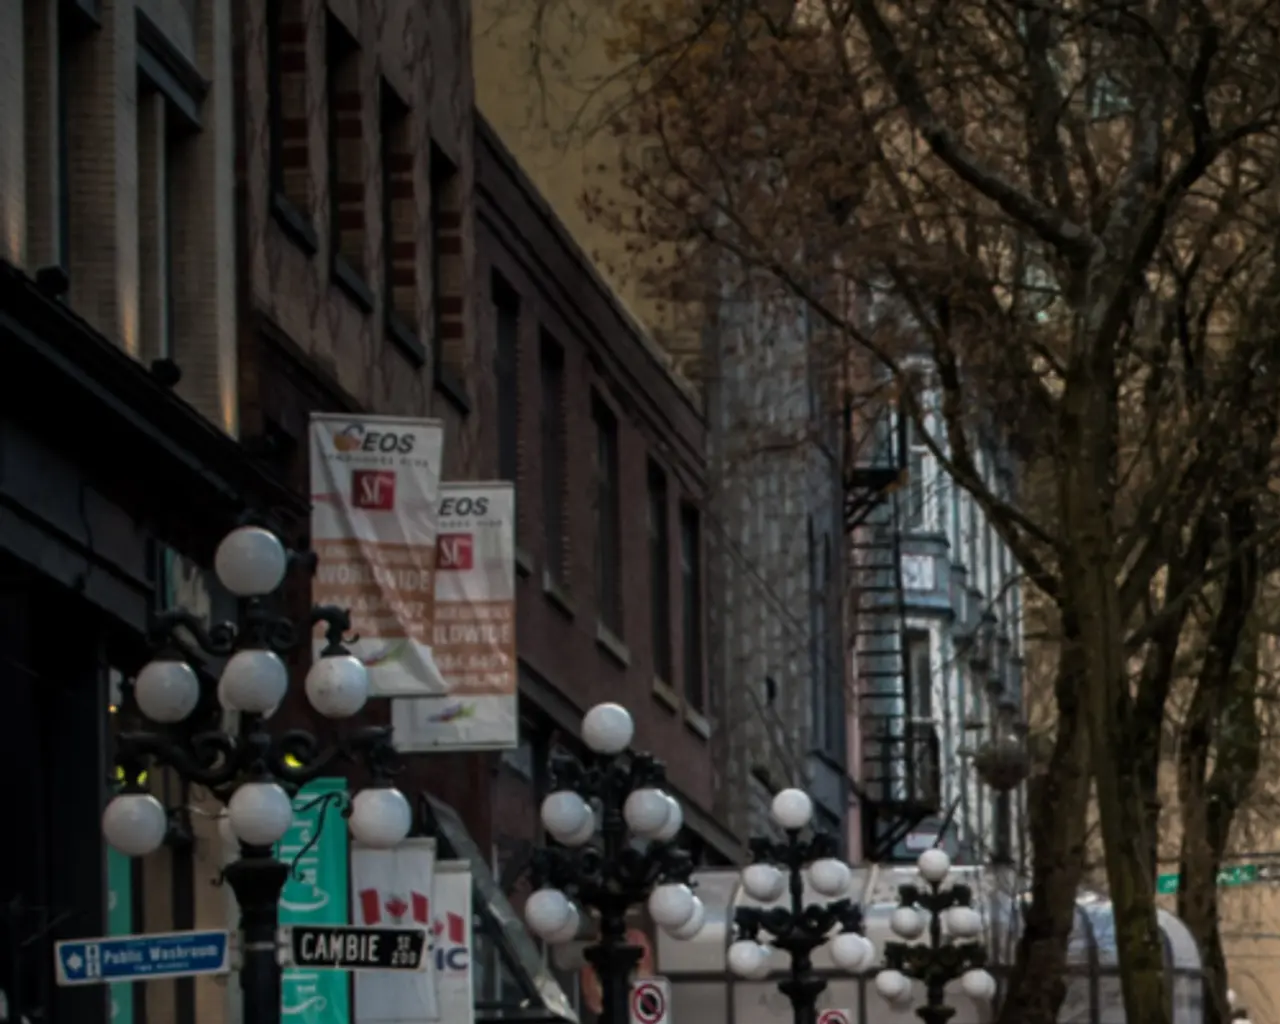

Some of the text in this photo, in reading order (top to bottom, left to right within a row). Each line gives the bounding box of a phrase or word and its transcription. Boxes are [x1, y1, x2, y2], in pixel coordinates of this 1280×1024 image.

[438, 497, 489, 517] EOS
[103, 945, 219, 964] Public Washroom
[302, 931, 382, 962] CAMBIE
